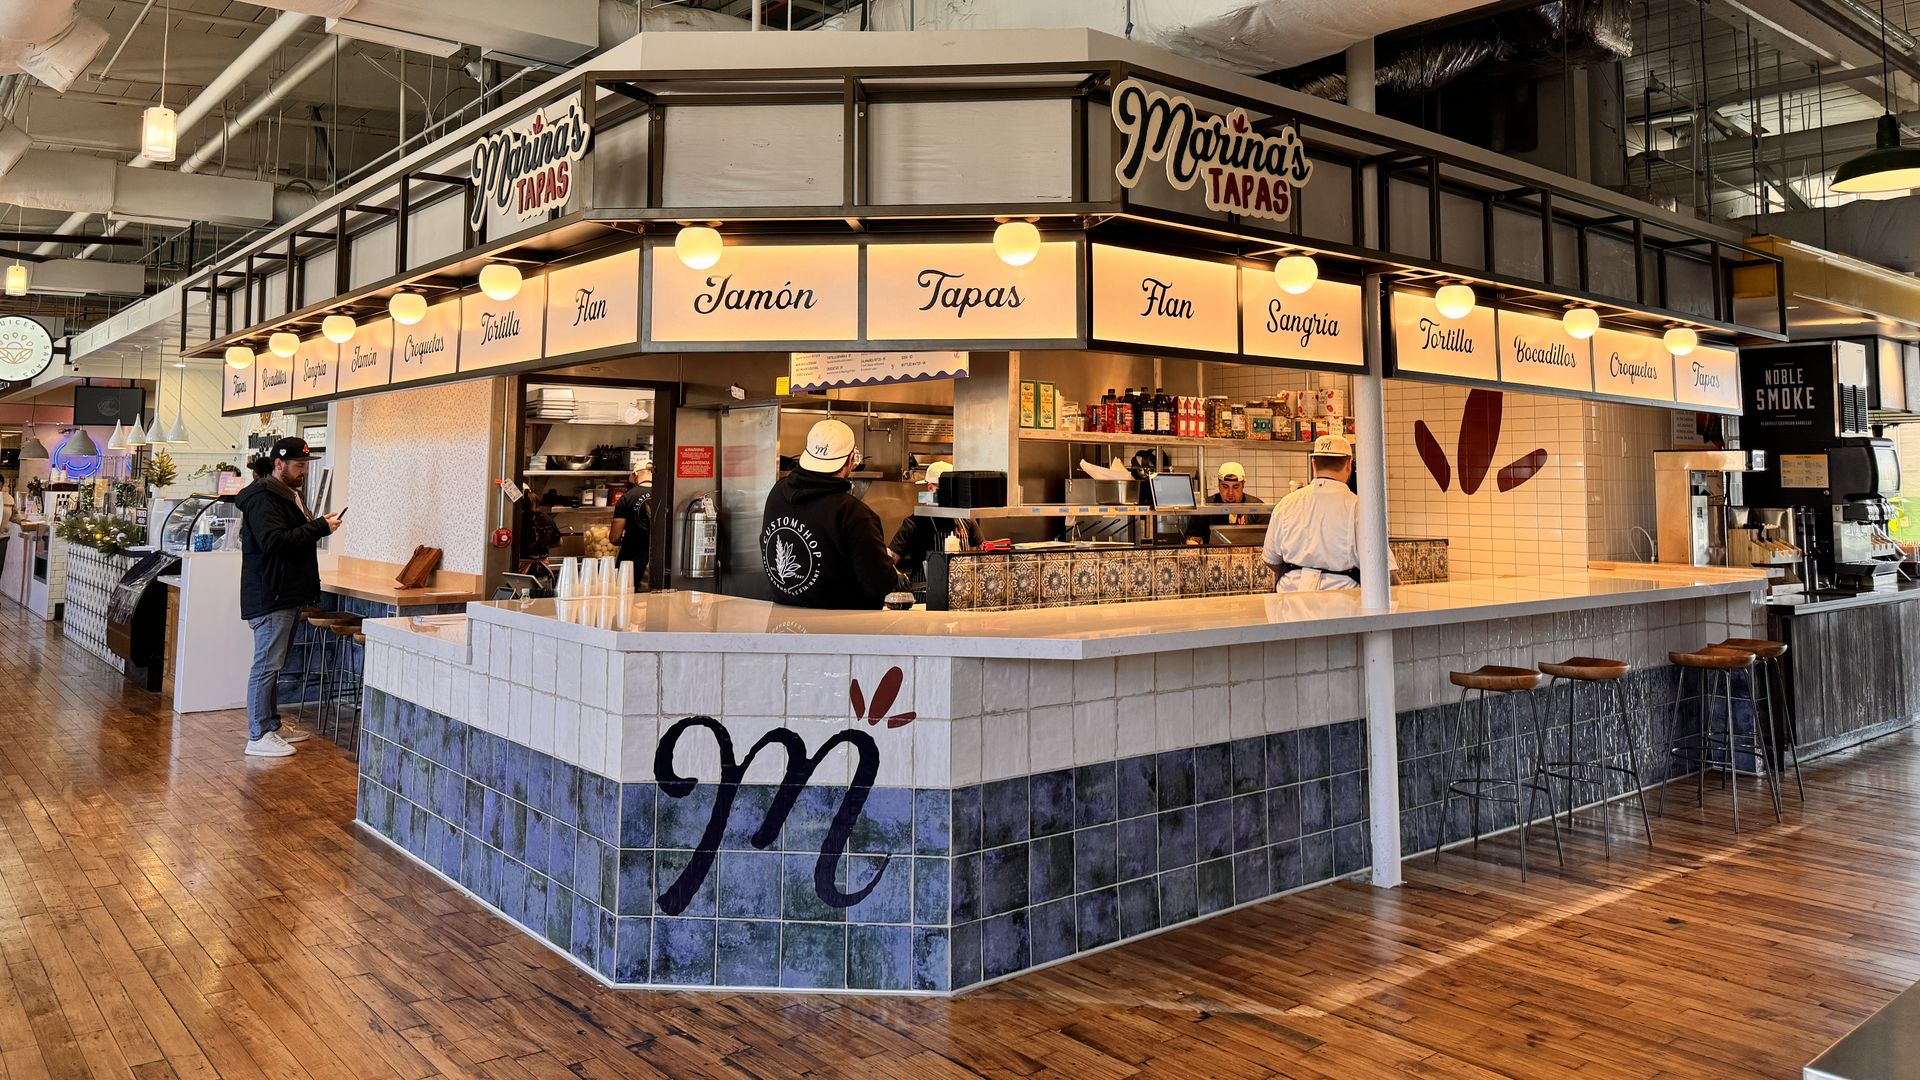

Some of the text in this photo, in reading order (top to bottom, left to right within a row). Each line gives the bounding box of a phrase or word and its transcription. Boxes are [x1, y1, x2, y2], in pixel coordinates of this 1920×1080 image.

[1119, 86, 1310, 182] Marina's
[472, 105, 585, 224] Marina's
[517, 161, 568, 214] TAPAS
[1209, 168, 1289, 214] TAPAS
[573, 286, 608, 327] Flan
[693, 273, 818, 314] Jamón
[917, 269, 1026, 318] Tapas
[1140, 277, 1195, 319] Flan
[0, 319, 36, 331] UICES
[480, 310, 520, 346] Tortilla
[1266, 298, 1340, 348] Sangría
[1419, 317, 1474, 353] Tortilla
[351, 345, 378, 373] Jamón
[404, 333, 444, 364] Croquetas
[1513, 334, 1577, 368] Bocadillos
[1610, 351, 1658, 385] Croquetas
[1691, 361, 1720, 392] Tapas
[1765, 368, 1804, 385] NOBLE
[233, 374, 247, 399] Tapas
[1756, 386, 1816, 411] SMOKE
[634, 492, 651, 511] CUSTO
[763, 516, 822, 558] CUSTOMSHOP
